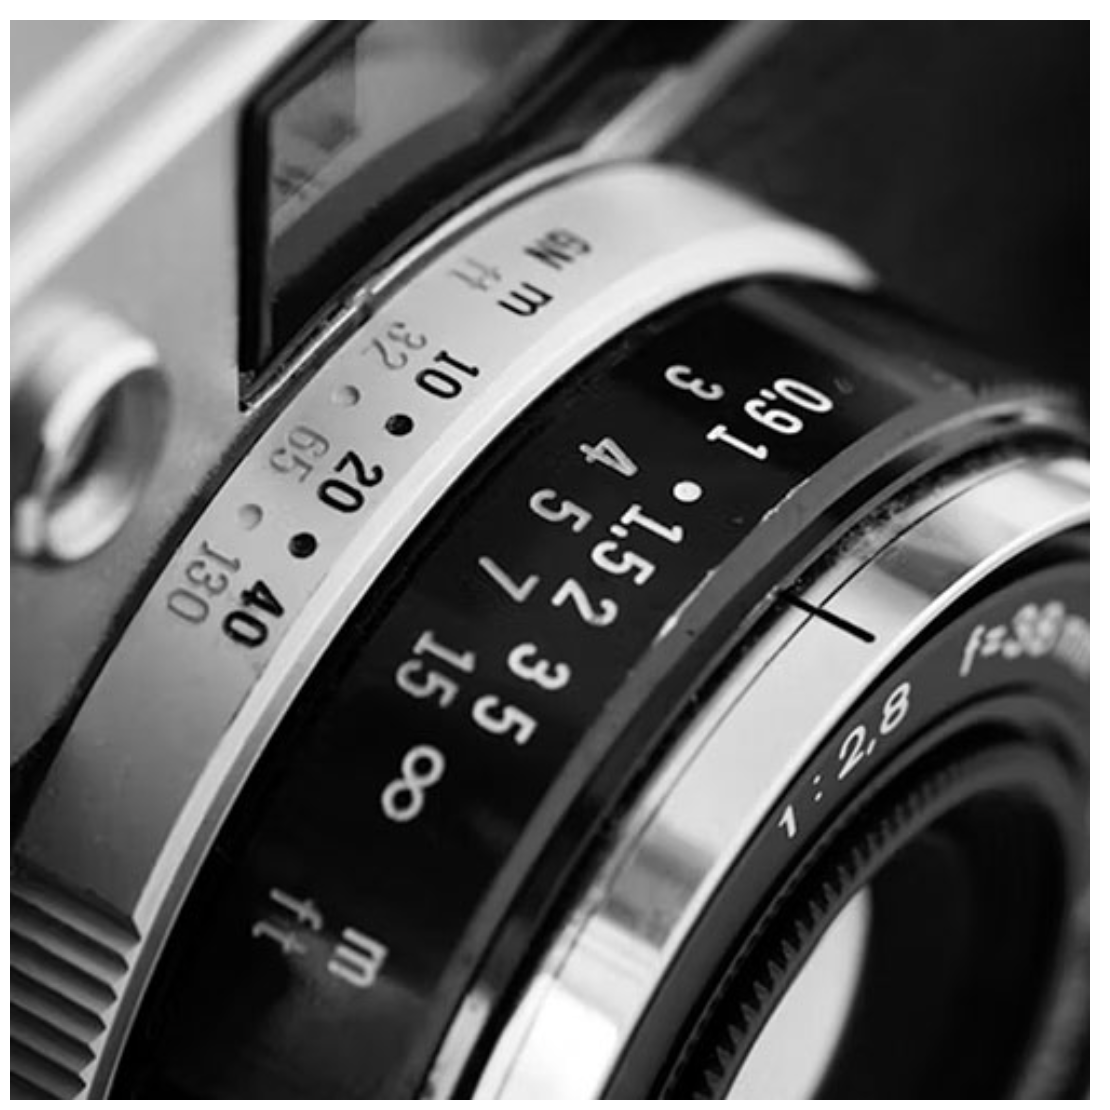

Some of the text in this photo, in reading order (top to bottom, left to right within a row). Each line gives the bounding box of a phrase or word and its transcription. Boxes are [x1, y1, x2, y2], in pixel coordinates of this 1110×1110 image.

[497, 281, 553, 317] m
[664, 364, 725, 400] 3
[579, 437, 638, 477] 4
[706, 424, 768, 460] 1
[221, 350, 480, 648] 10 20 40
[529, 488, 592, 533] 5
[478, 555, 539, 601] 7
[550, 578, 619, 626] 2
[395, 630, 476, 708] 15
[507, 642, 571, 691] 3
[471, 695, 537, 744] 5
[327, 926, 388, 988] m
